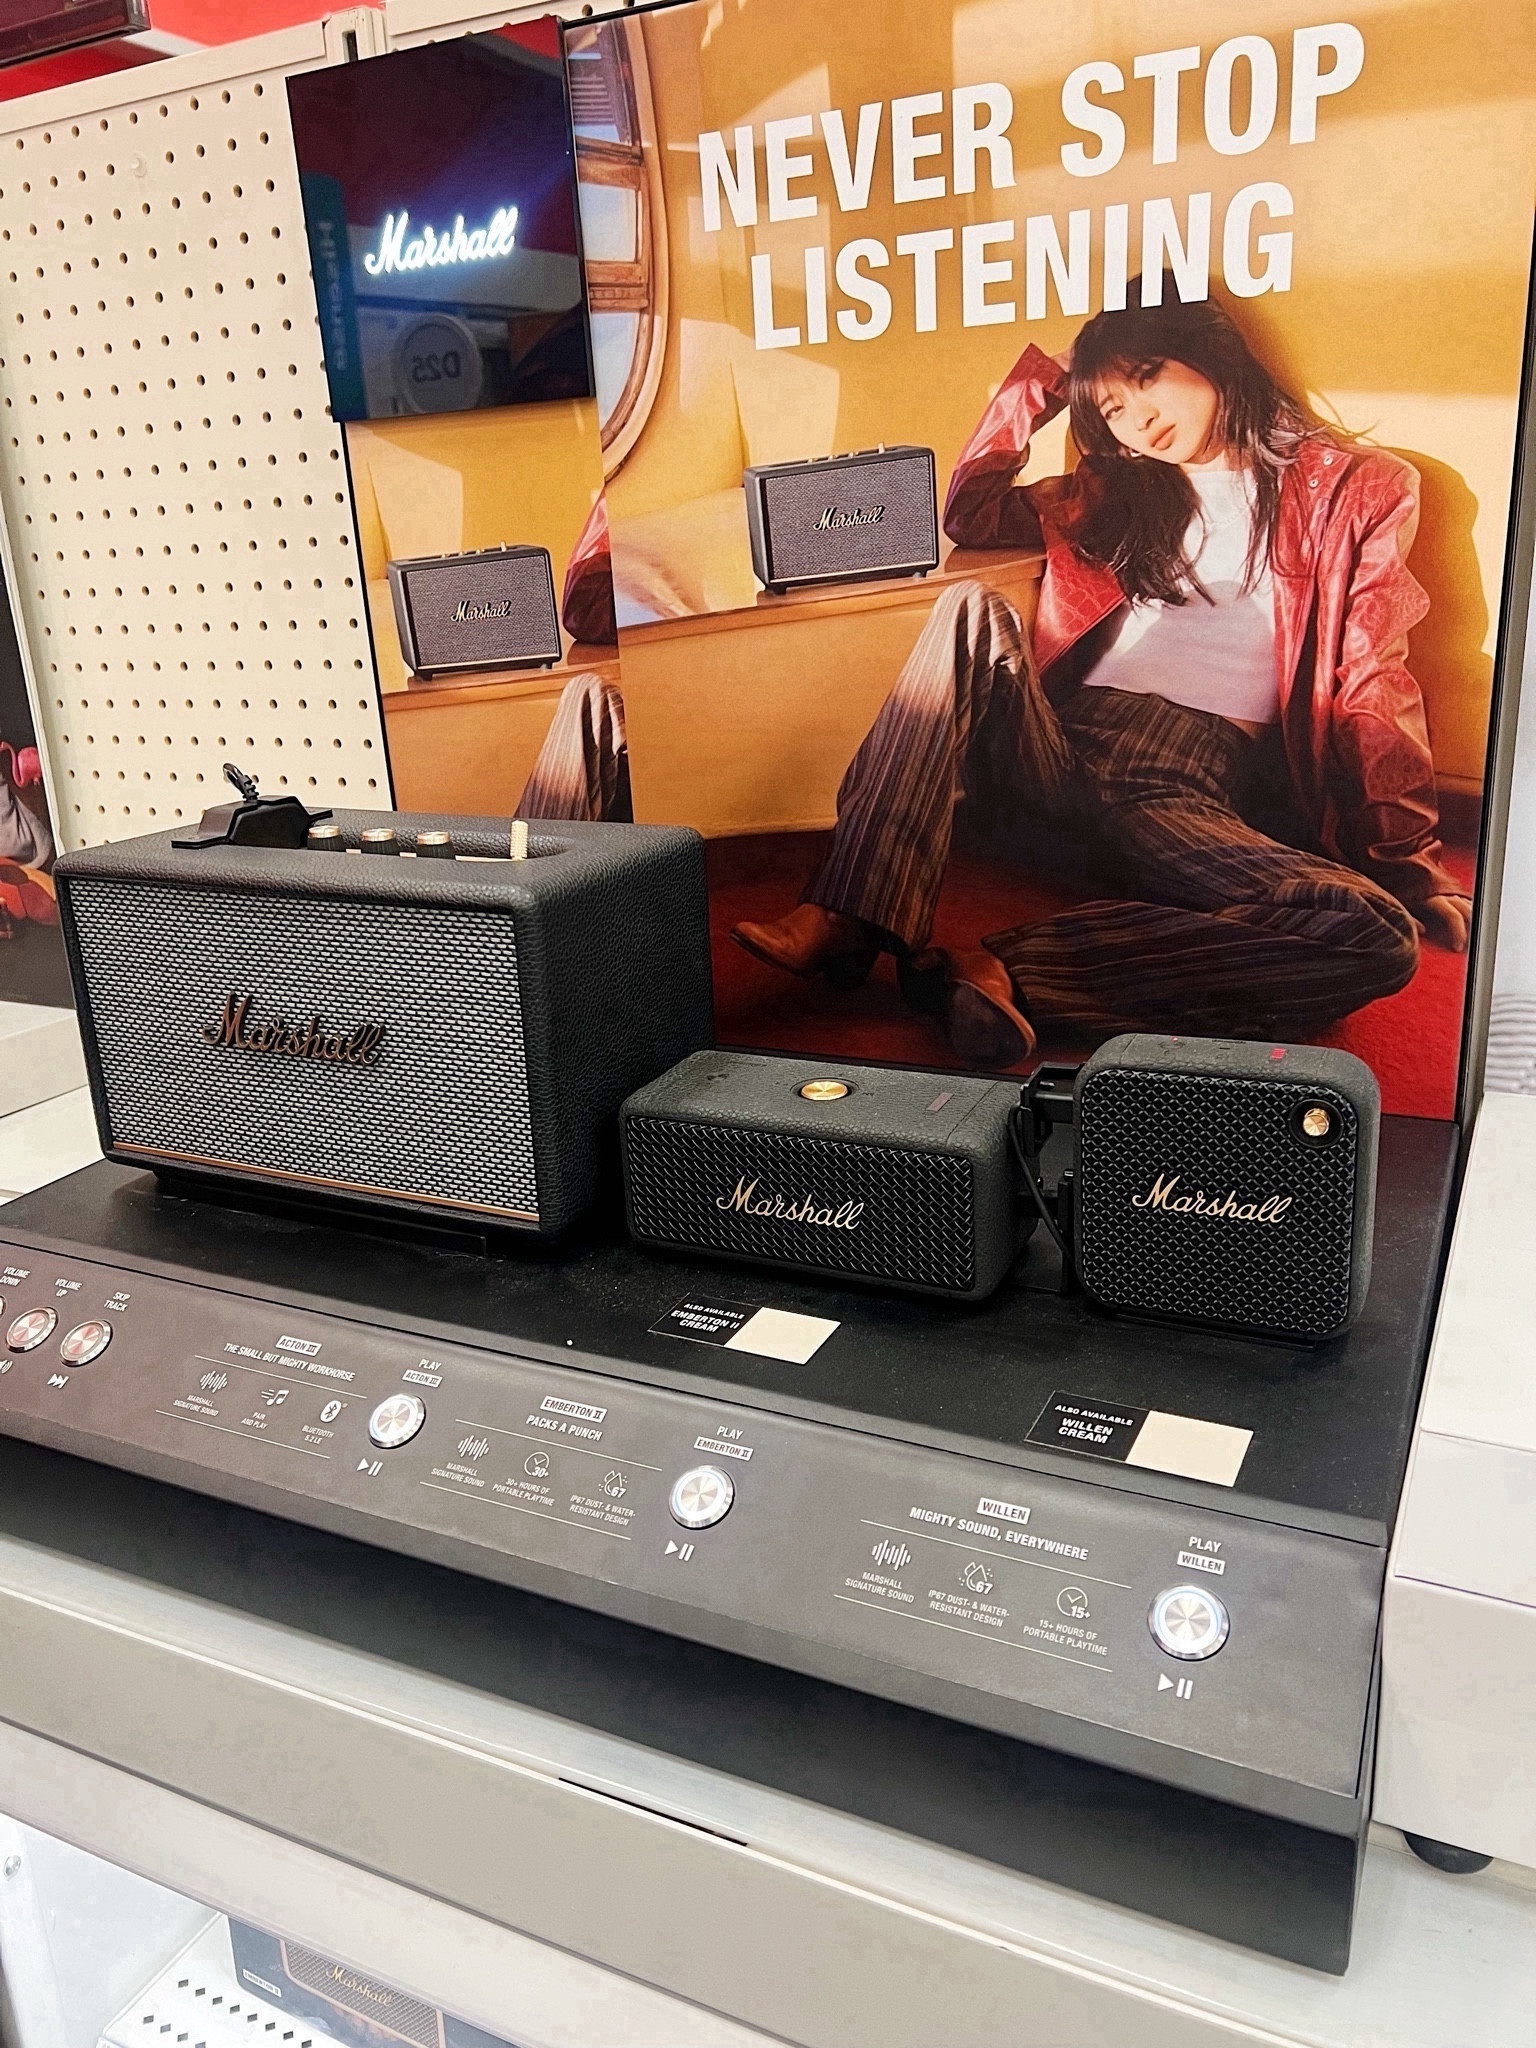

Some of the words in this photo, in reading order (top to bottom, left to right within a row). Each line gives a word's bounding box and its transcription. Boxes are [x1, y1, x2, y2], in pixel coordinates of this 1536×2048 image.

[698, 83, 1017, 232] NEVER
[1061, 22, 1365, 178] STOP
[364, 206, 518, 275] Marshall
[751, 182, 1294, 350] LISTENING
[813, 505, 886, 531] Marshall
[451, 600, 511, 623] Marshall
[202, 993, 386, 1066] Marshall
[717, 1176, 864, 1231] Marshall
[1132, 1173, 1293, 1224] Marshall
[0, 1275, 21, 1286] DOWN
[4, 1266, 31, 1279] VOLUME
[55, 1278, 82, 1291] VOLUME
[56, 1289, 68, 1297] UP
[113, 1291, 131, 1301] SKIP
[104, 1300, 128, 1312] TRACK
[683, 1303, 702, 1312] ALSO
[703, 1307, 745, 1320] AVAILABLE
[671, 1310, 728, 1328] EMBERTON
[679, 1319, 719, 1333] CREAM
[280, 1338, 306, 1350] ACTON
[307, 1344, 317, 1353] III
[223, 1343, 240, 1354] THE
[239, 1346, 262, 1359] SMALL
[262, 1352, 279, 1363] BUT
[278, 1355, 308, 1370] MIGHTY
[307, 1363, 355, 1382] WORKHORSE
[419, 1359, 442, 1370] PLAY
[405, 1371, 429, 1383] ACTON
[429, 1377, 439, 1386] III
[173, 1400, 201, 1412] SIGNATURE
[200, 1407, 219, 1417] SOUND
[187, 1395, 214, 1407] MARSHALL
[544, 1399, 592, 1417] EMBERTON
[593, 1411, 603, 1419] II
[241, 1417, 253, 1426] AND
[252, 1420, 268, 1430] PLAY
[252, 1412, 266, 1421] PAIR
[1054, 1405, 1080, 1414] ALSO
[1081, 1410, 1134, 1426] AVAILABLE
[302, 1425, 334, 1439] BLUETOOTH
[526, 1415, 559, 1431] PACKS
[558, 1423, 567, 1433] A
[568, 1425, 603, 1441] PUNCH
[717, 1426, 743, 1440] PLAY
[1058, 1426, 1109, 1444] CREAM
[1061, 1417, 1114, 1436] WILLEN
[697, 1439, 741, 1456] EMBERTON
[741, 1450, 750, 1458] II
[431, 1468, 464, 1483] SIGNATURE
[464, 1476, 485, 1488] SOUND
[446, 1463, 477, 1477] MARSHALL
[531, 1466, 549, 1478] 30+
[492, 1484, 524, 1499] PORTABLE
[523, 1491, 555, 1507] PLAYTIME
[505, 1478, 518, 1487] 30+
[519, 1481, 541, 1494] HOURS
[540, 1487, 550, 1495] OF
[611, 1487, 626, 1498] 67
[569, 1505, 604, 1520] RESISTANT
[604, 1513, 630, 1526] DESIGN
[570, 1495, 585, 1505] IP67
[585, 1498, 605, 1509] DUST-
[604, 1503, 611, 1511] &
[611, 1505, 636, 1518] WATER-
[983, 1501, 1027, 1521] WILLEN
[909, 1507, 956, 1527] MIGHTY
[957, 1519, 1002, 1541] SOUND,
[1005, 1531, 1089, 1561] EVERYWHERE
[1188, 1536, 1222, 1553] PLAY
[1182, 1554, 1221, 1572] WILLEN
[862, 1571, 903, 1590] MARSHALL
[975, 1581, 994, 1595] 67
[845, 1578, 887, 1597] SIGNATURE
[887, 1588, 915, 1603] SOUND
[928, 1589, 946, 1602] IP67
[946, 1593, 971, 1608] DUST-
[971, 1600, 978, 1610] &
[979, 1602, 1010, 1617] WATER-
[1070, 1604, 1091, 1620] 15+
[929, 1600, 972, 1620] RESISTANT
[972, 1611, 1004, 1627] DESIGN
[1039, 1618, 1054, 1630] 15+
[1056, 1622, 1086, 1639] HOURS
[1086, 1631, 1098, 1641] OF
[1023, 1625, 1065, 1645] PORTABLE
[1066, 1635, 1108, 1656] PLAYTIME
[326, 1964, 393, 2008] Marshall
